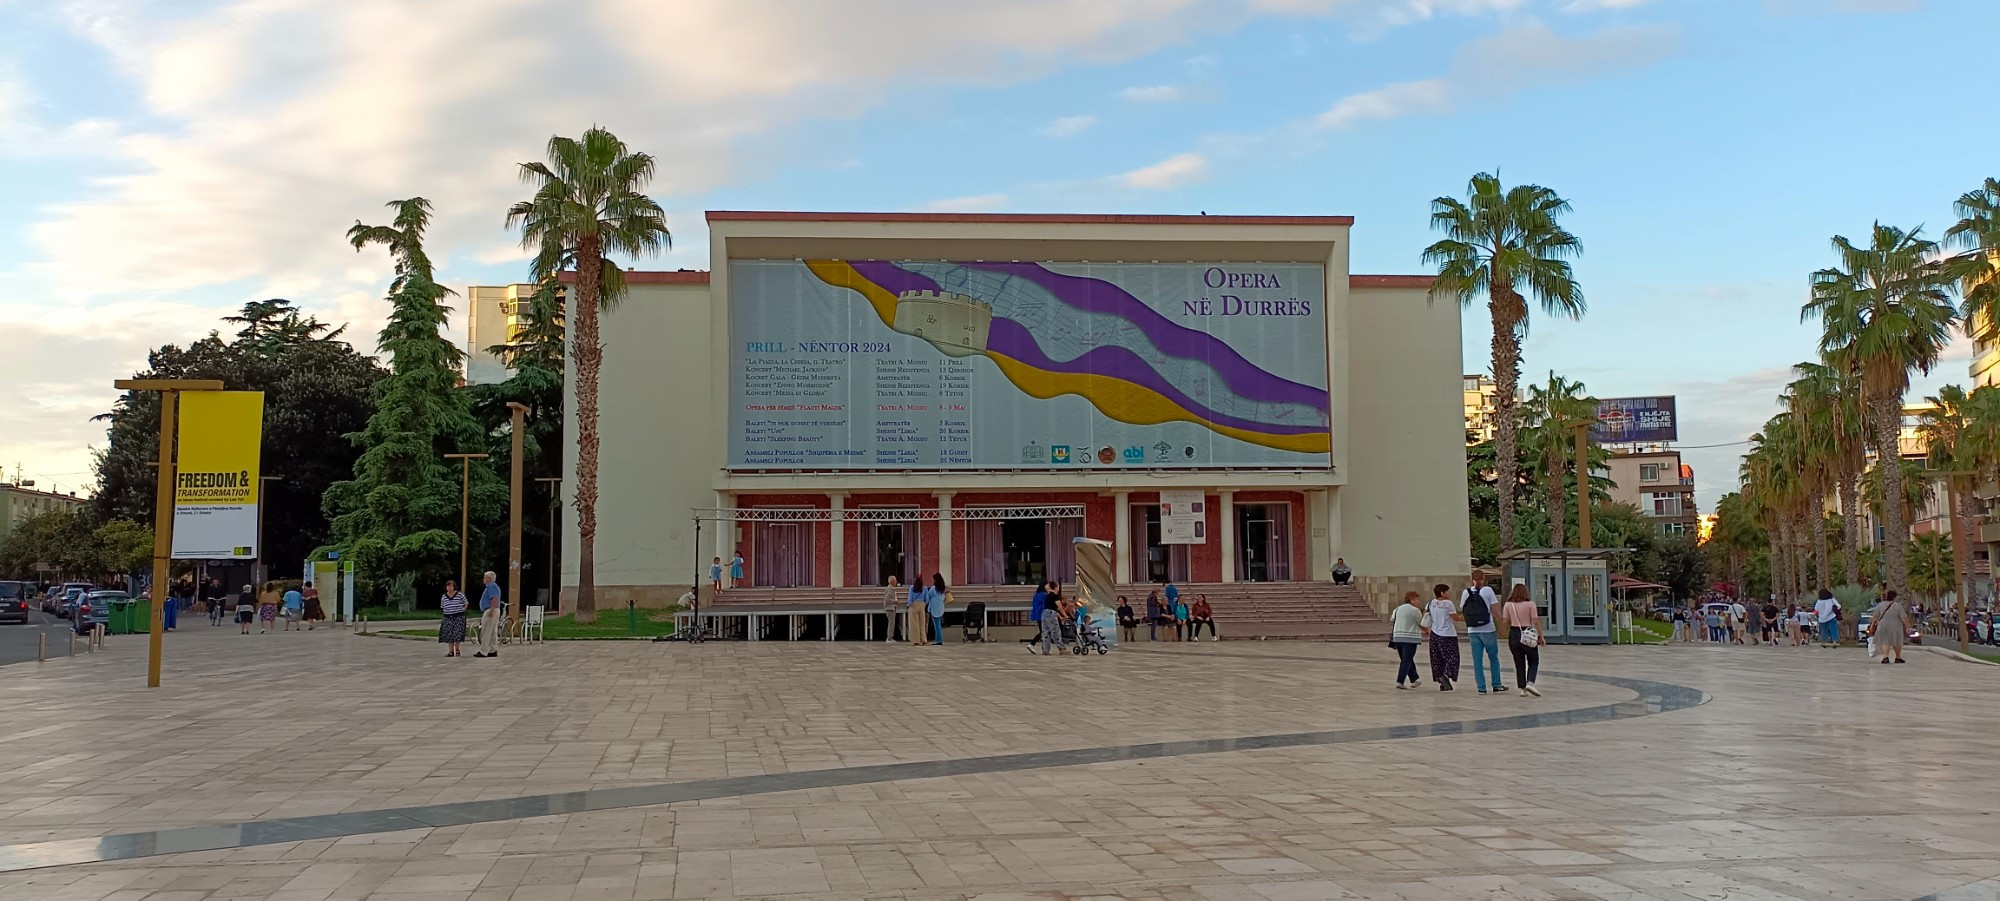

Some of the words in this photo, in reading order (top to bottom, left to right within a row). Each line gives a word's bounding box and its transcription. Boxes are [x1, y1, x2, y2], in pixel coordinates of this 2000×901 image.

[1203, 267, 1281, 288] OPERA
[1220, 295, 1311, 316] DURRËS
[747, 342, 787, 352] PRILL
[799, 341, 859, 353] NËNTOR
[863, 342, 891, 353] 2024
[178, 472, 237, 488] FREEDOM
[240, 470, 249, 487] &
[177, 489, 250, 497] TRANSFORMATION
